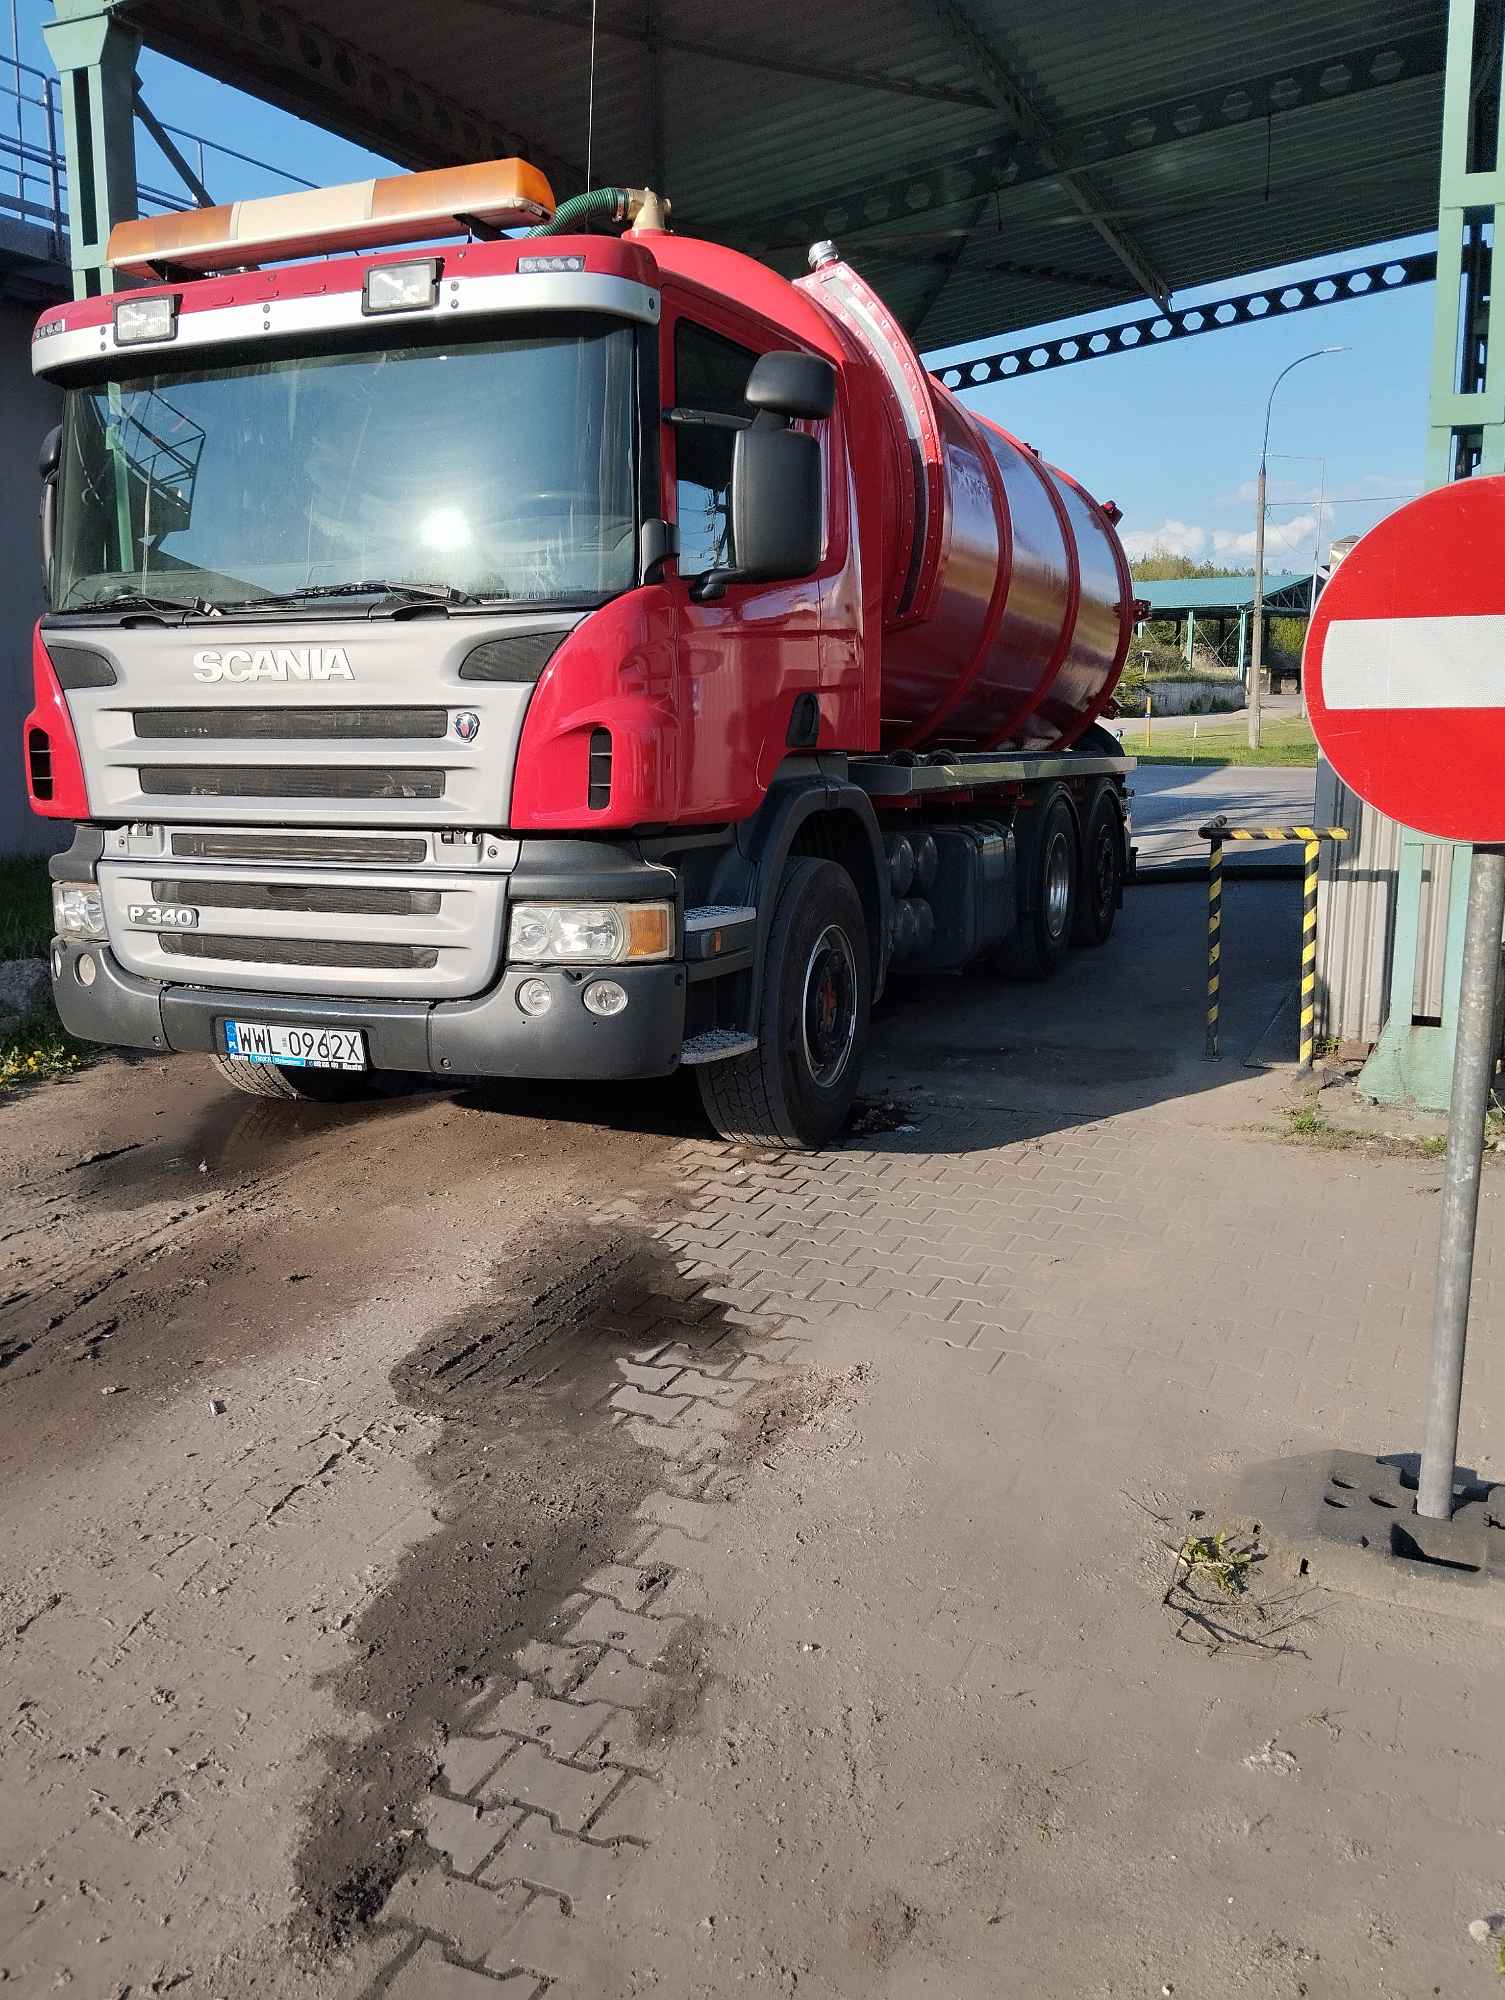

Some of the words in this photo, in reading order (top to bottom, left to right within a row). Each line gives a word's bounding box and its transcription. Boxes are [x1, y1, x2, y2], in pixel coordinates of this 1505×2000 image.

[193, 648, 356, 683] SCANIA
[130, 906, 145, 922] P
[147, 908, 193, 926] 340
[238, 1026, 281, 1055] WWL
[288, 1031, 361, 1061] 0962X
